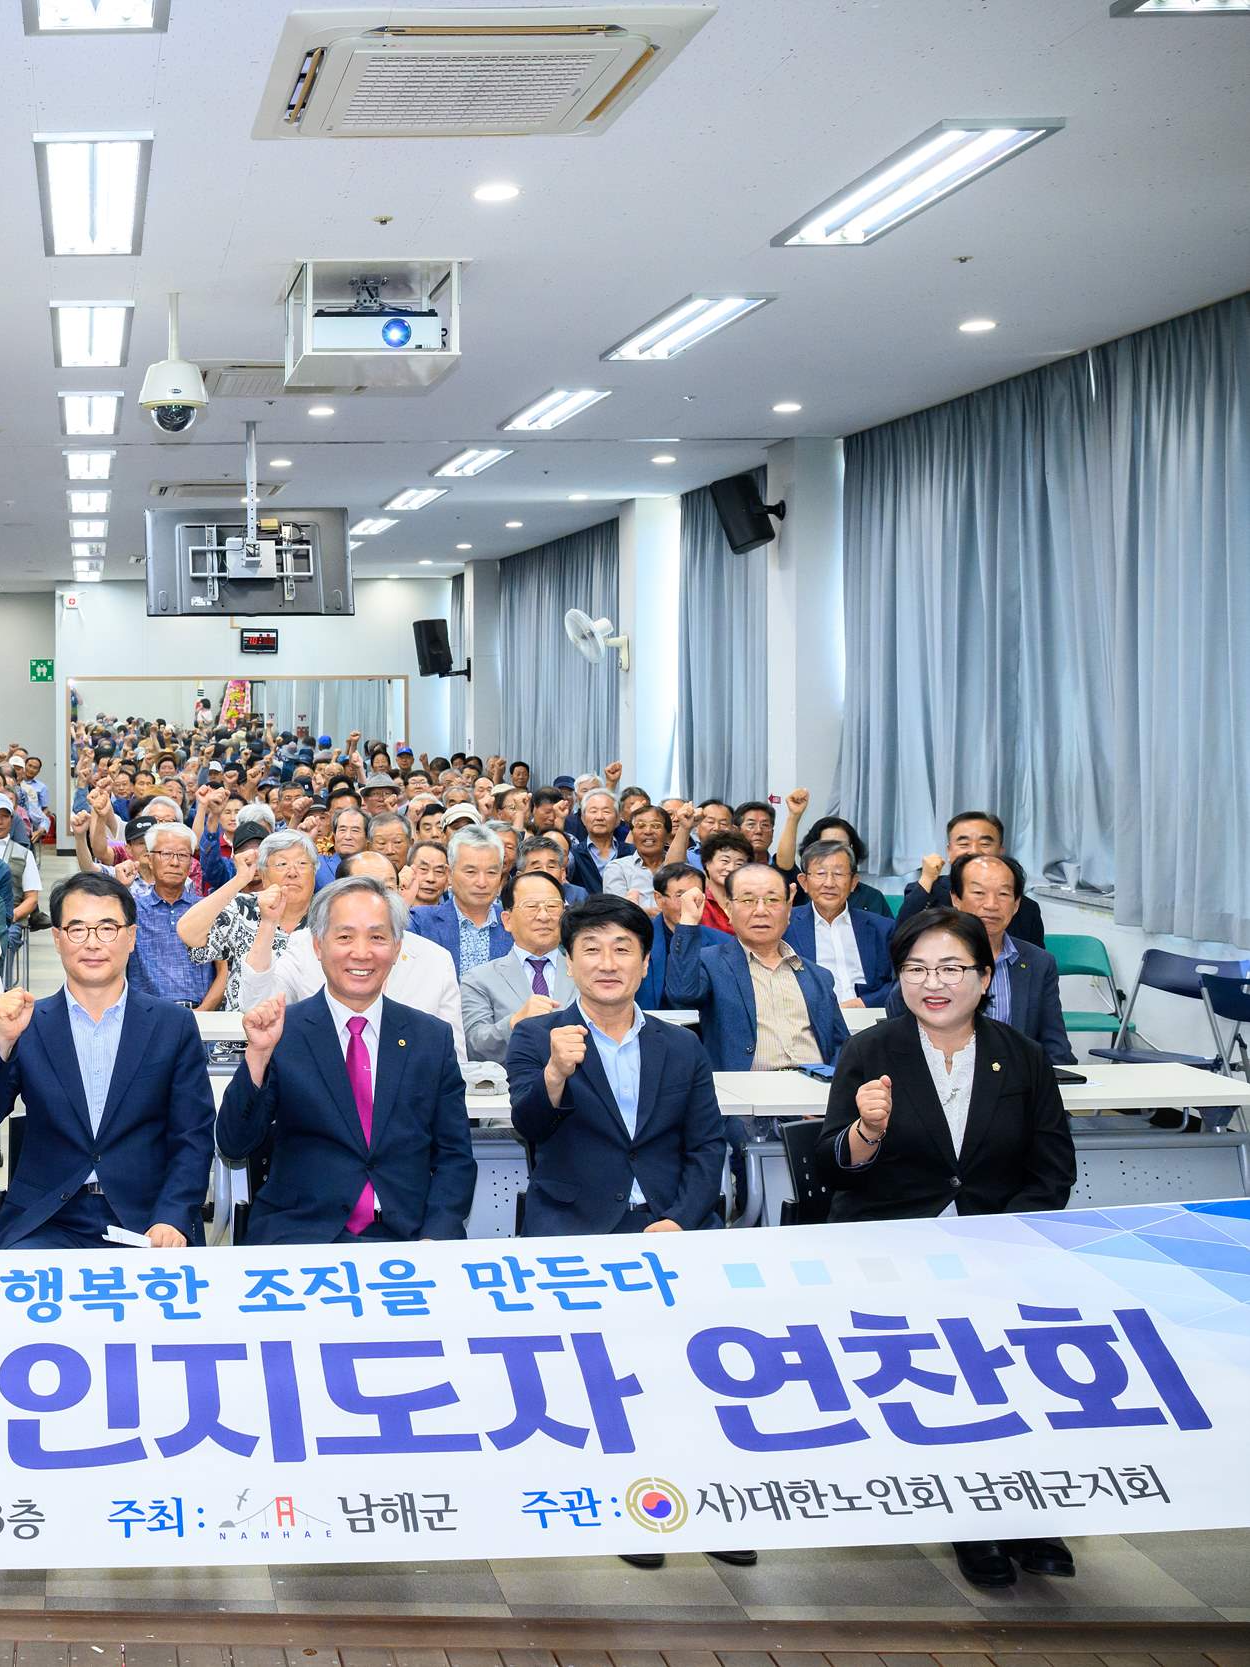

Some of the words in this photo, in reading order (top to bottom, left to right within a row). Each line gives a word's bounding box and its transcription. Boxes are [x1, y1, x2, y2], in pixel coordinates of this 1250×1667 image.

[0, 1265, 209, 1323] 행복한
[238, 1259, 436, 1317] 조직을
[462, 1252, 678, 1312] 만든다
[687, 1303, 1212, 1452] 연찬회
[338, 1492, 458, 1533] 남해군
[696, 1474, 953, 1522] 사)대한노인회
[954, 1465, 1170, 1511] 남해군지회
[219, 1529, 332, 1540] NAMHAE
